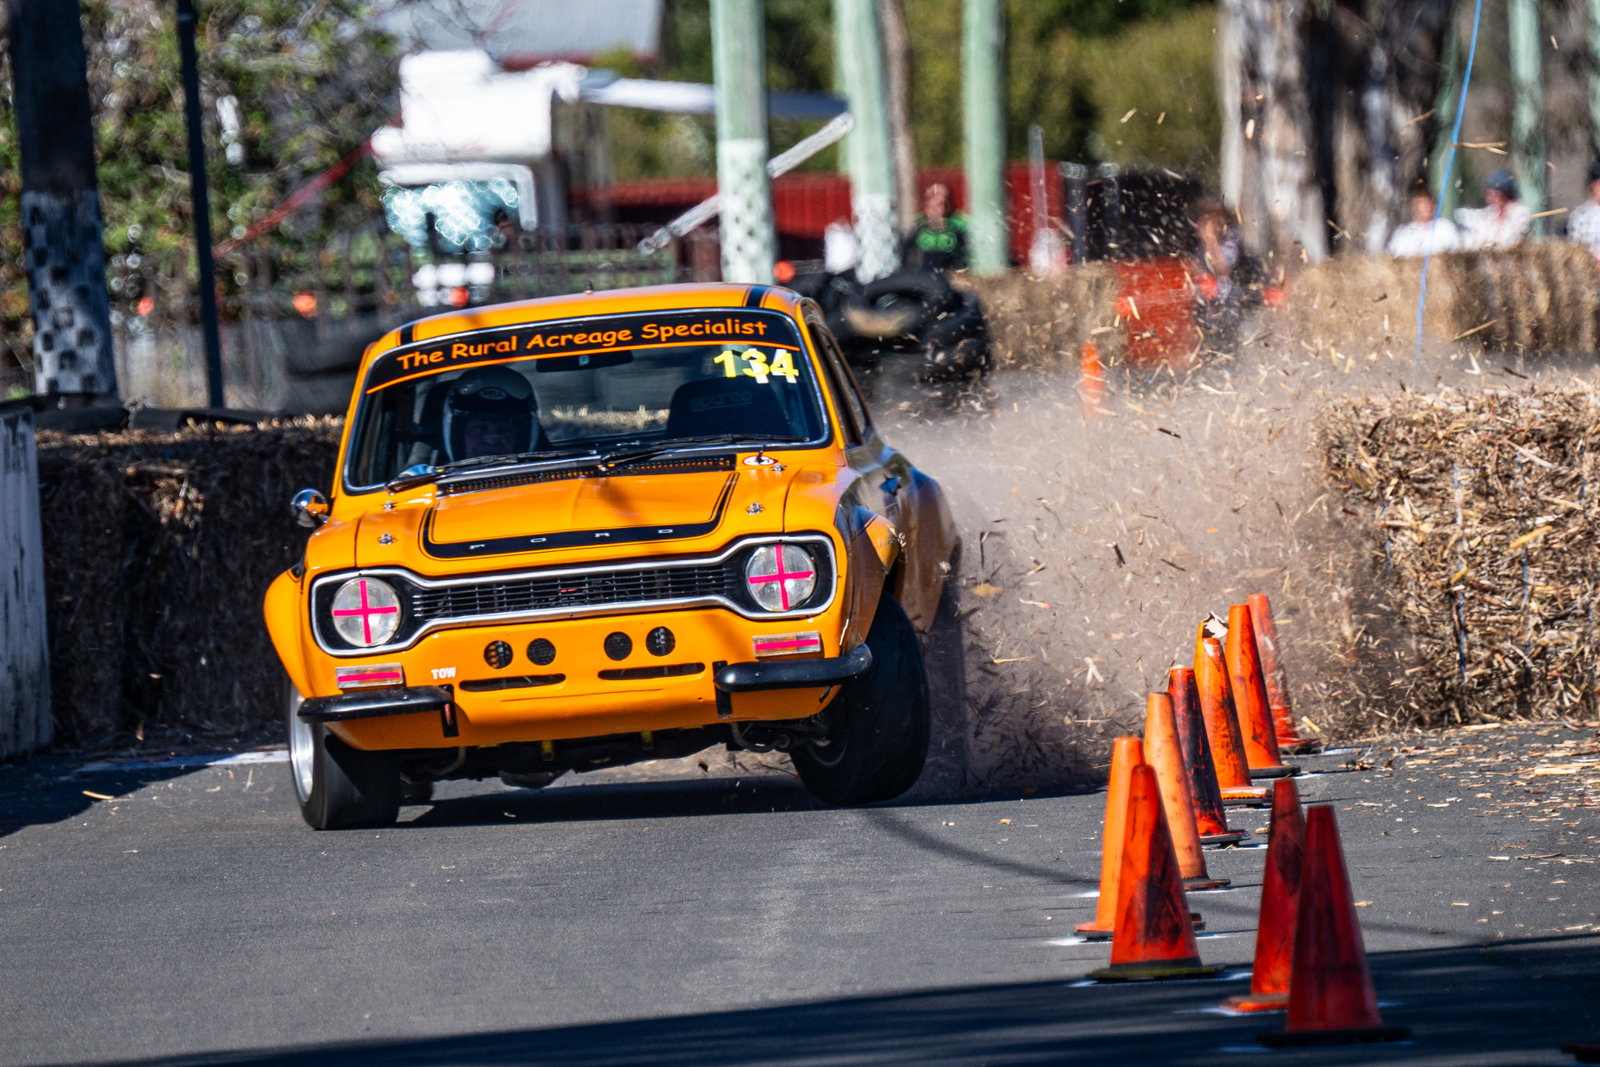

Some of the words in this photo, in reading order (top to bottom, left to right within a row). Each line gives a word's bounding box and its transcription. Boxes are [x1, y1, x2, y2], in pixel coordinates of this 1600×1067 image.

[397, 351, 444, 369] The
[451, 335, 517, 359] Rural
[526, 328, 633, 347] Acreage
[641, 318, 767, 342] Specialist
[714, 349, 799, 380] 134
[469, 528, 673, 550] FORD
[430, 667, 456, 680] TOW
